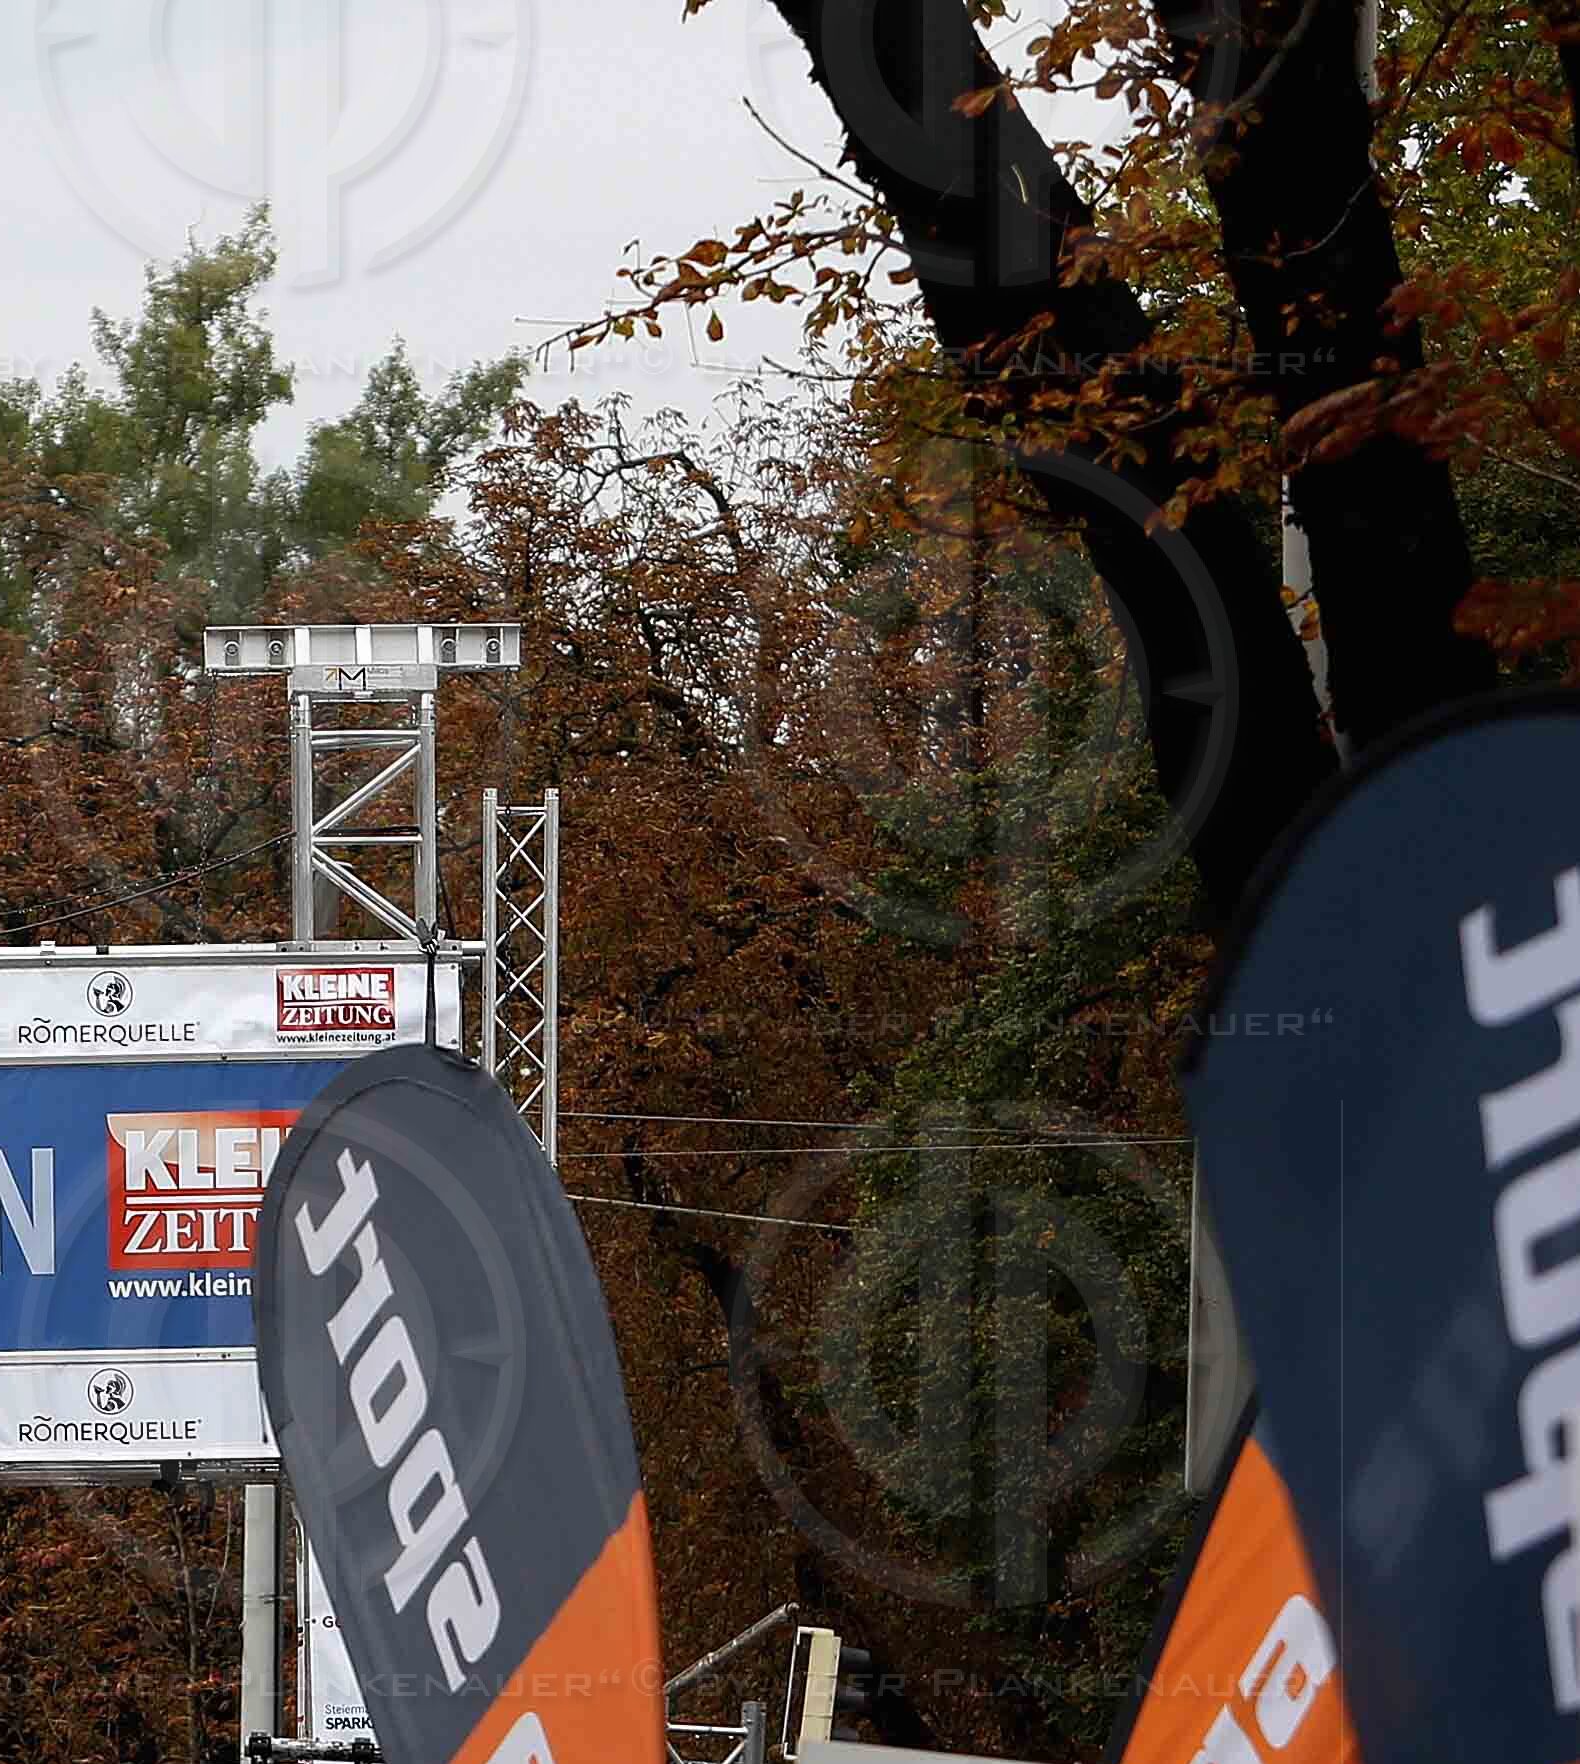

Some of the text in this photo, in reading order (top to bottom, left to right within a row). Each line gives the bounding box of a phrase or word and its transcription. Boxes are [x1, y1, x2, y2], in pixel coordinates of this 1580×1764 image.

[283, 972, 389, 1000] KLEINE
[282, 1004, 393, 1026] ZEITUNG
[276, 1031, 396, 1043] www.kleinezeitung.at
